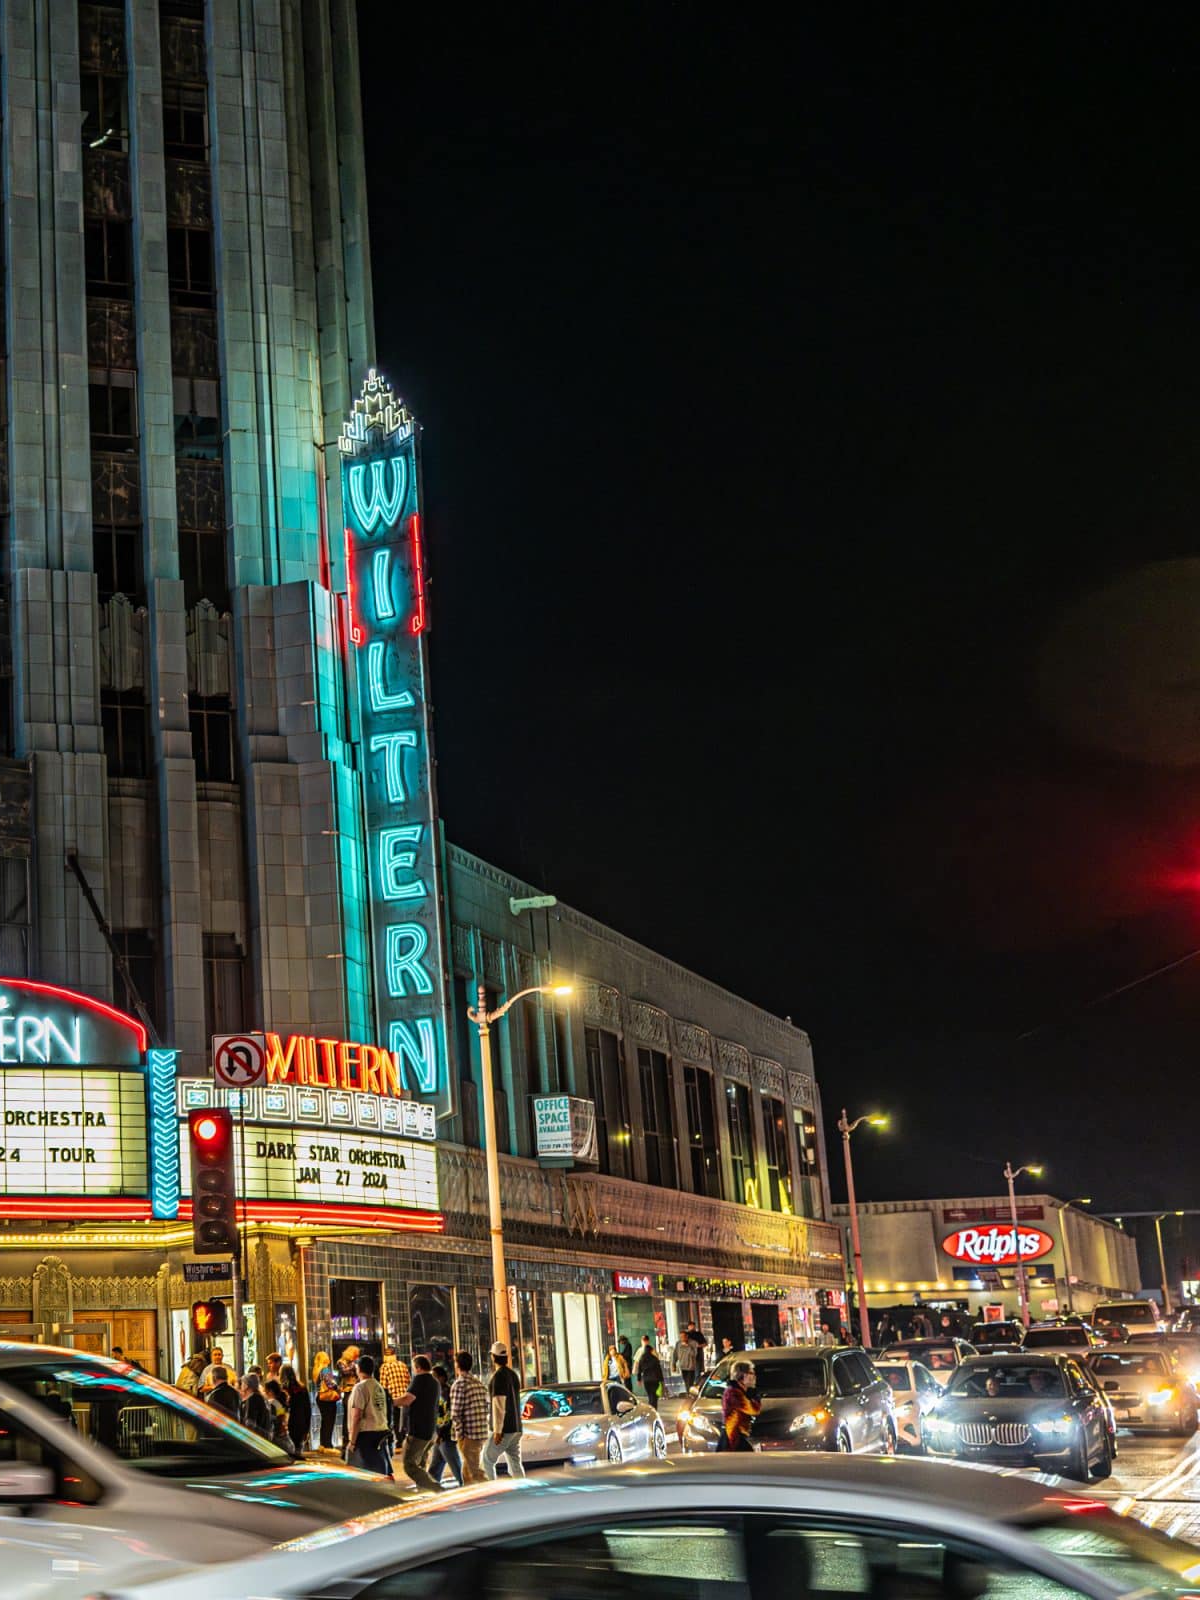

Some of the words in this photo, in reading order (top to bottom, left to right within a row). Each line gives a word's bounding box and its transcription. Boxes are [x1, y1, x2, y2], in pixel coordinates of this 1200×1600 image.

[349, 456, 437, 1093] WILTERN
[264, 1032, 402, 1097] WILTERN
[536, 1098, 568, 1111] OFFICE
[4, 1110, 107, 1127] ORCHESTRA
[538, 1112, 569, 1125] SPACE
[49, 1147, 97, 1163] TOUR
[256, 1141, 297, 1160] DARK
[309, 1145, 340, 1163] STAR
[348, 1148, 407, 1170] ORCHESTRA
[296, 1167, 321, 1185] JAN
[336, 1169, 350, 1186] 27
[362, 1171, 388, 1189] 2024
[956, 1228, 1040, 1262] Ralphs
